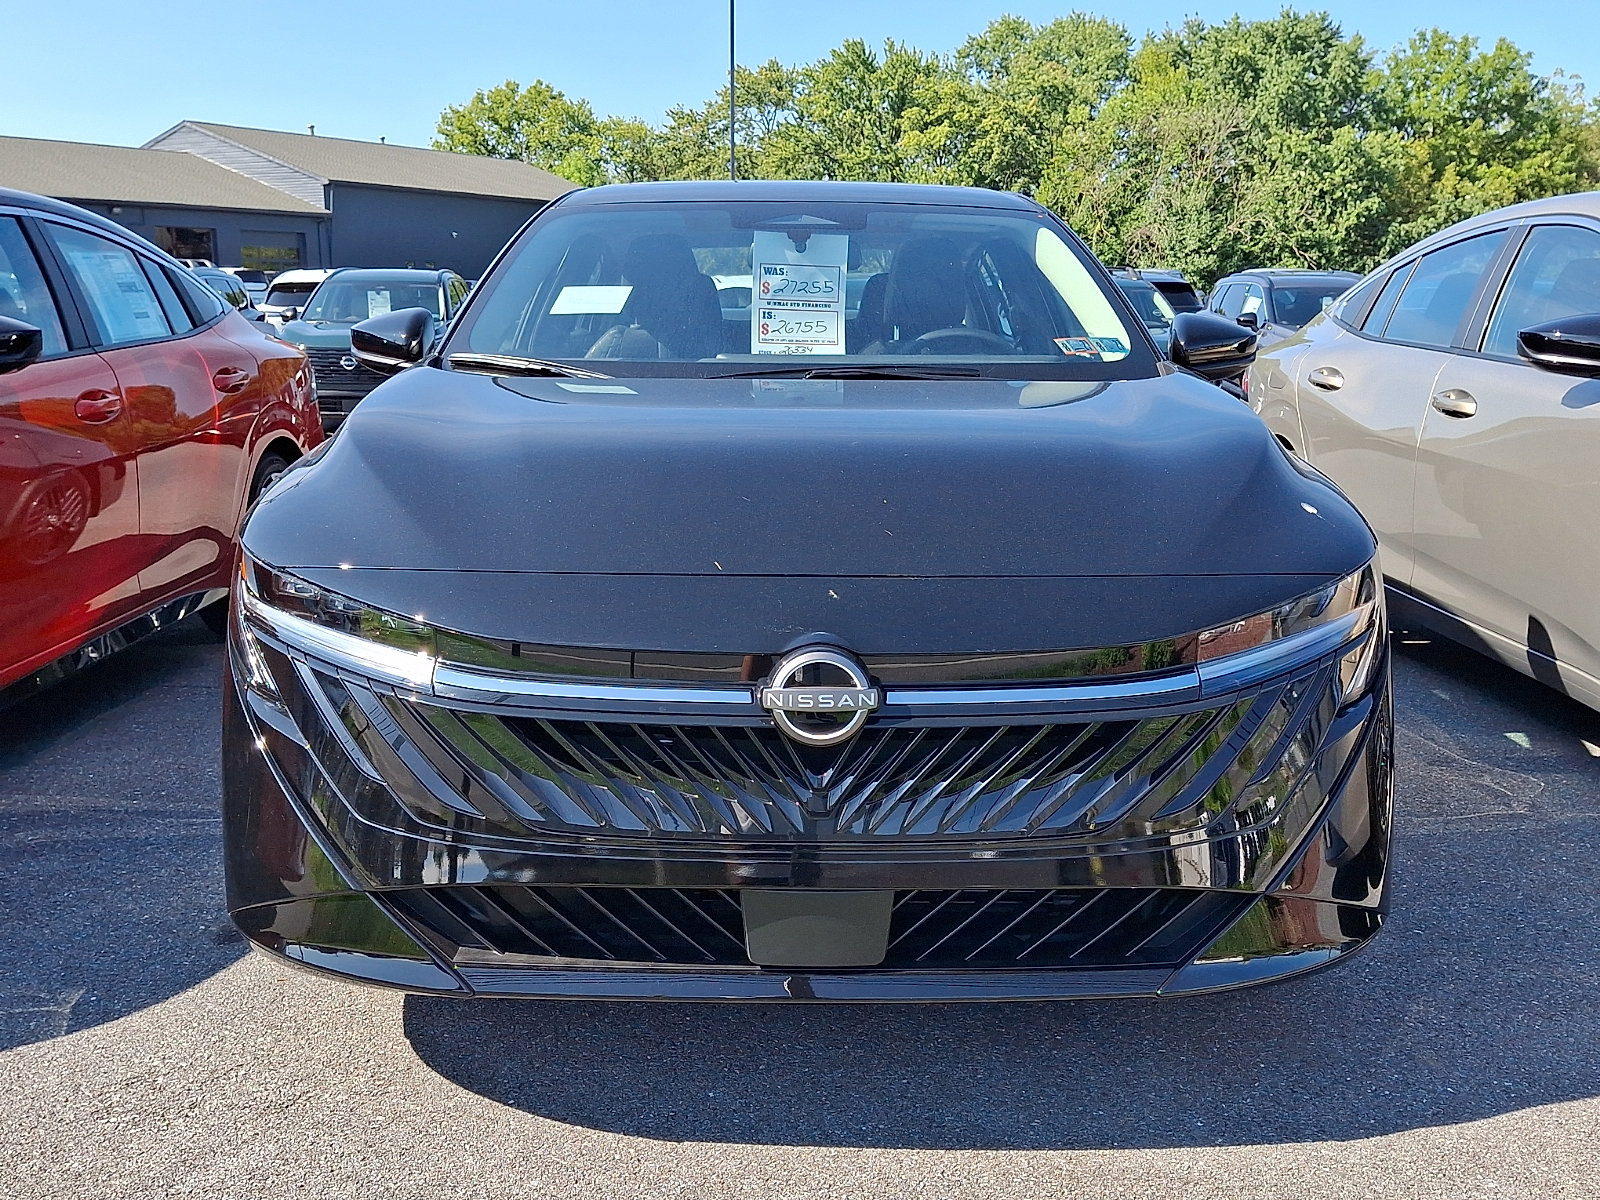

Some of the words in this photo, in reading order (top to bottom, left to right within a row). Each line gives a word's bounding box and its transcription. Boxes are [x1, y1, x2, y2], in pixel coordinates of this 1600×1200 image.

[763, 266, 789, 276] WAS:
[773, 278, 834, 295] 27255
[762, 311, 777, 320] IS:
[771, 320, 828, 335] 26755
[766, 692, 875, 708] NISSAN
